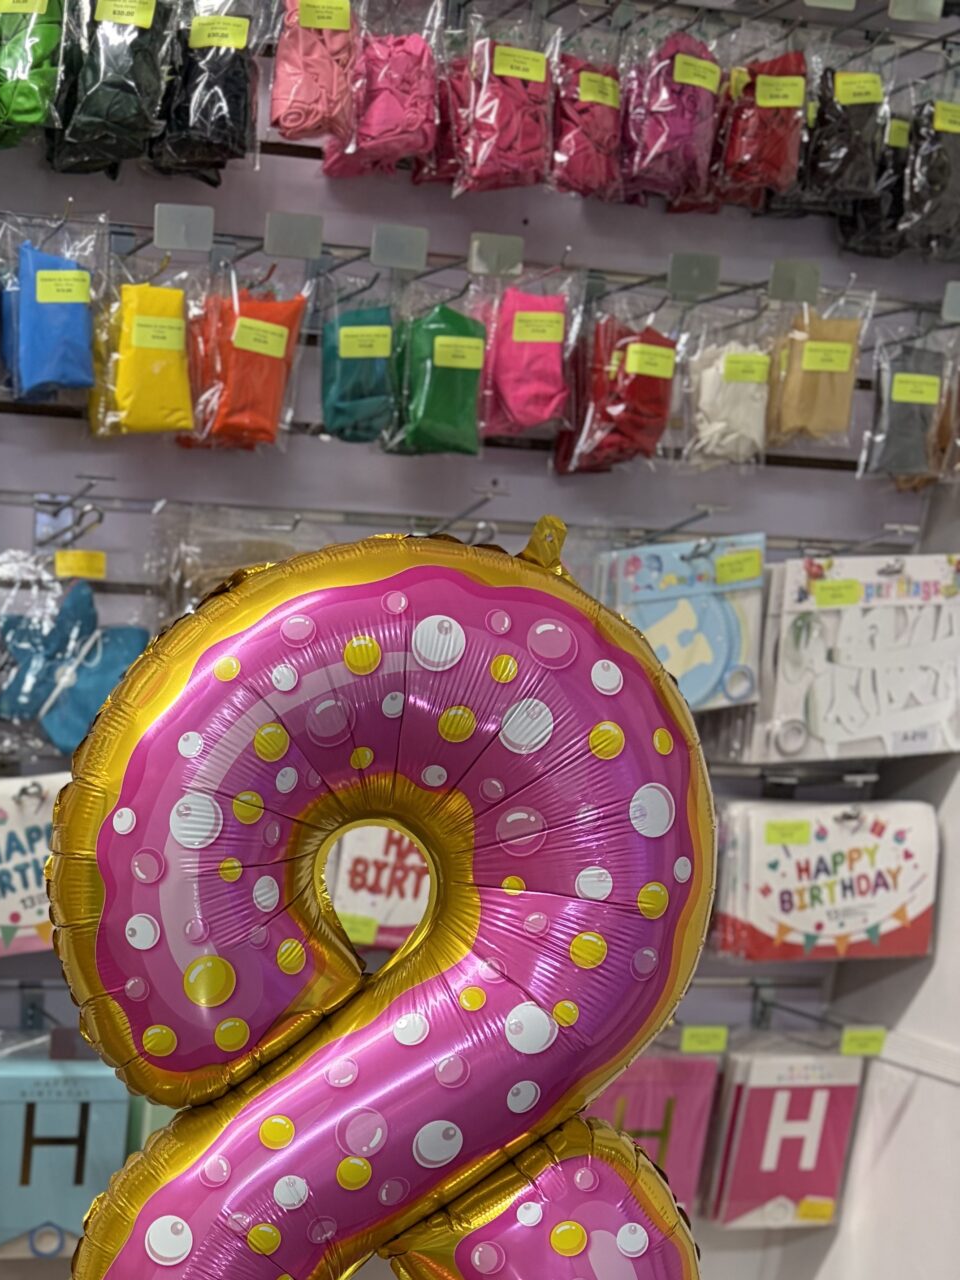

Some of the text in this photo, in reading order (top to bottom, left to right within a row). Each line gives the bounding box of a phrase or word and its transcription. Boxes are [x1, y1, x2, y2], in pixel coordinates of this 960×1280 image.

[348, 856, 429, 900] BIRT
[796, 845, 880, 881] HAPPY
[779, 866, 902, 914] BIRTHDAY
[18, 1101, 91, 1187] H
[759, 1089, 831, 1173] H
